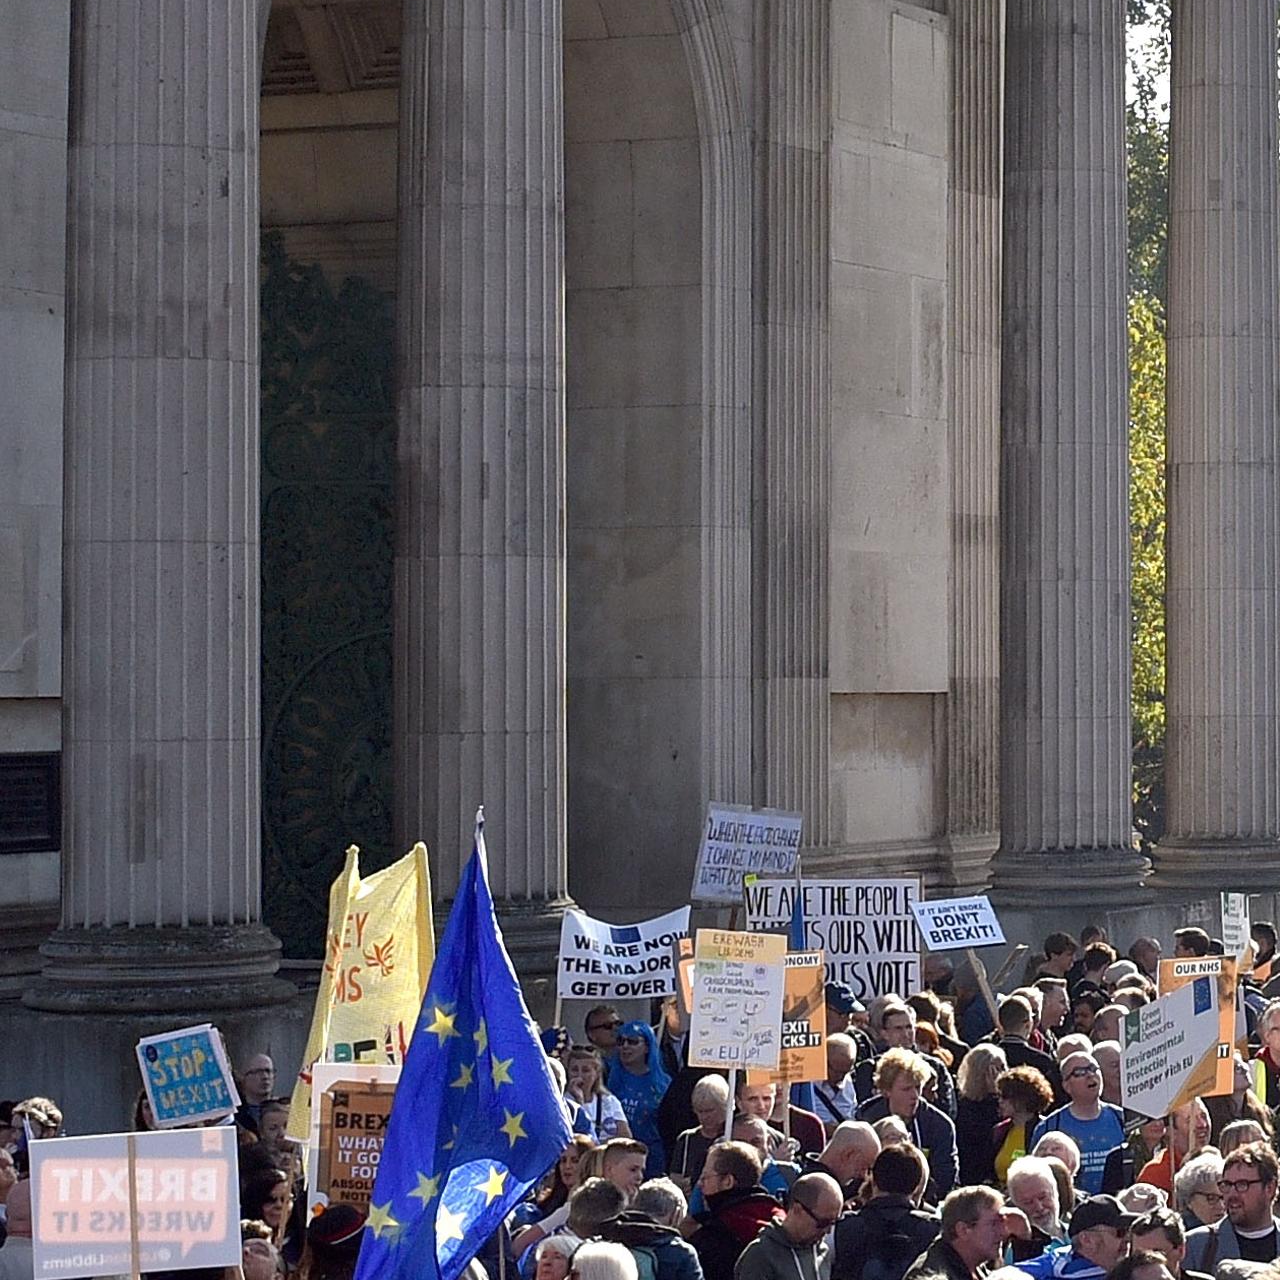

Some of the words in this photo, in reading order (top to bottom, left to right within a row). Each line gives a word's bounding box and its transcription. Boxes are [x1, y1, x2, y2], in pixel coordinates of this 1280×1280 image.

[747, 886, 773, 917] WE
[821, 886, 852, 916] THE
[856, 885, 916, 916] PEOPLE
[933, 912, 980, 926] DON'T
[829, 920, 870, 954] OUR
[875, 920, 920, 954] WILL
[930, 925, 996, 944] BREXIT!
[574, 934, 600, 953] WE
[604, 944, 640, 958] ARE
[645, 931, 688, 951] NOW
[563, 957, 602, 974] THE
[606, 955, 671, 975] MAJOR
[1176, 965, 1196, 974] OUR
[1200, 962, 1219, 973] NHS
[571, 982, 610, 996] GET
[615, 979, 666, 996] OVER
[867, 960, 917, 999] VOTE
[783, 1021, 809, 1033] EXIT
[809, 1034, 820, 1045] IT
[719, 1046, 739, 1060] EU
[1126, 1031, 1184, 1069] Environmental
[1218, 1044, 1230, 1058] IT
[148, 1047, 206, 1087] STOP
[1127, 1074, 1162, 1097] Stronger
[1183, 1055, 1193, 1067] EU
[335, 1112, 391, 1130] BREX
[338, 1151, 352, 1163] IT
